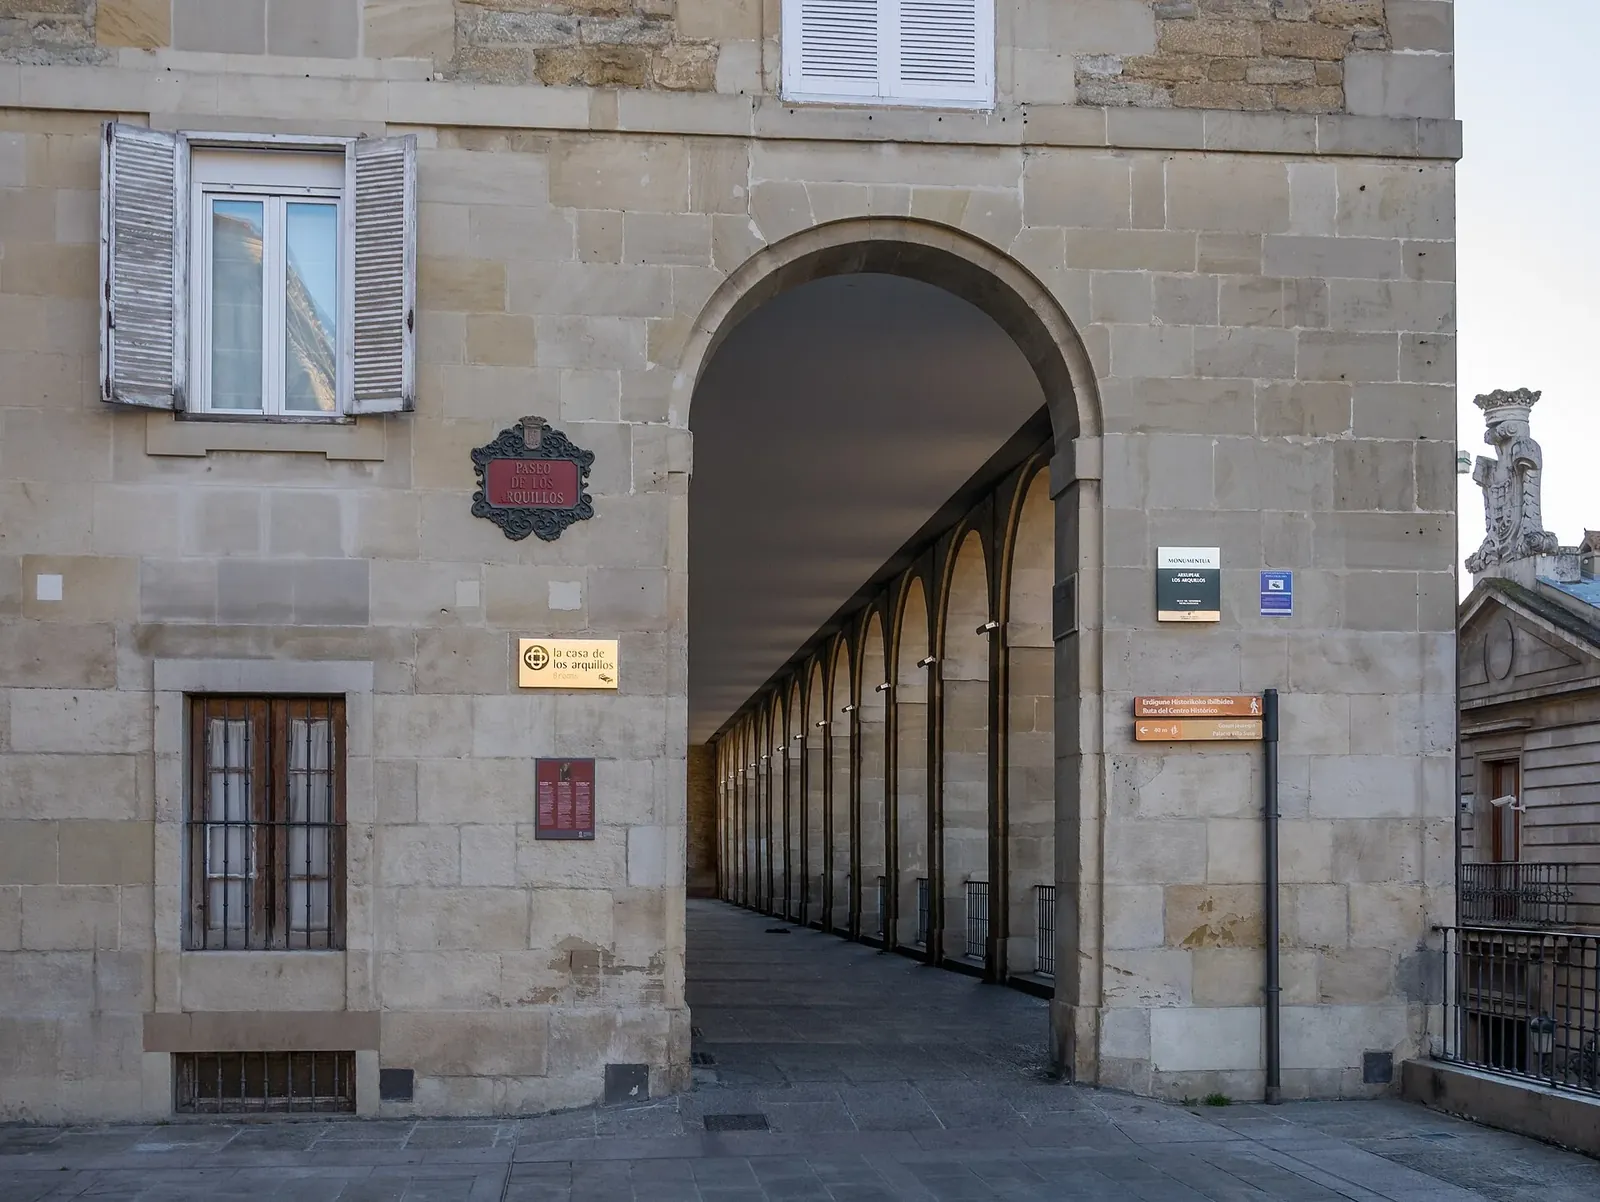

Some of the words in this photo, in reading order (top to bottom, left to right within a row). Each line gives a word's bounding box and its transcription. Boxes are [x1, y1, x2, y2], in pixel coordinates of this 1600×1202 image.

[516, 462, 551, 475] PASEO
[511, 476, 526, 489] DE
[531, 476, 554, 489] LOS
[553, 648, 562, 658] la
[566, 650, 589, 658] casa
[592, 649, 605, 658] de
[553, 659, 568, 669] los
[571, 660, 614, 672] arquillos
